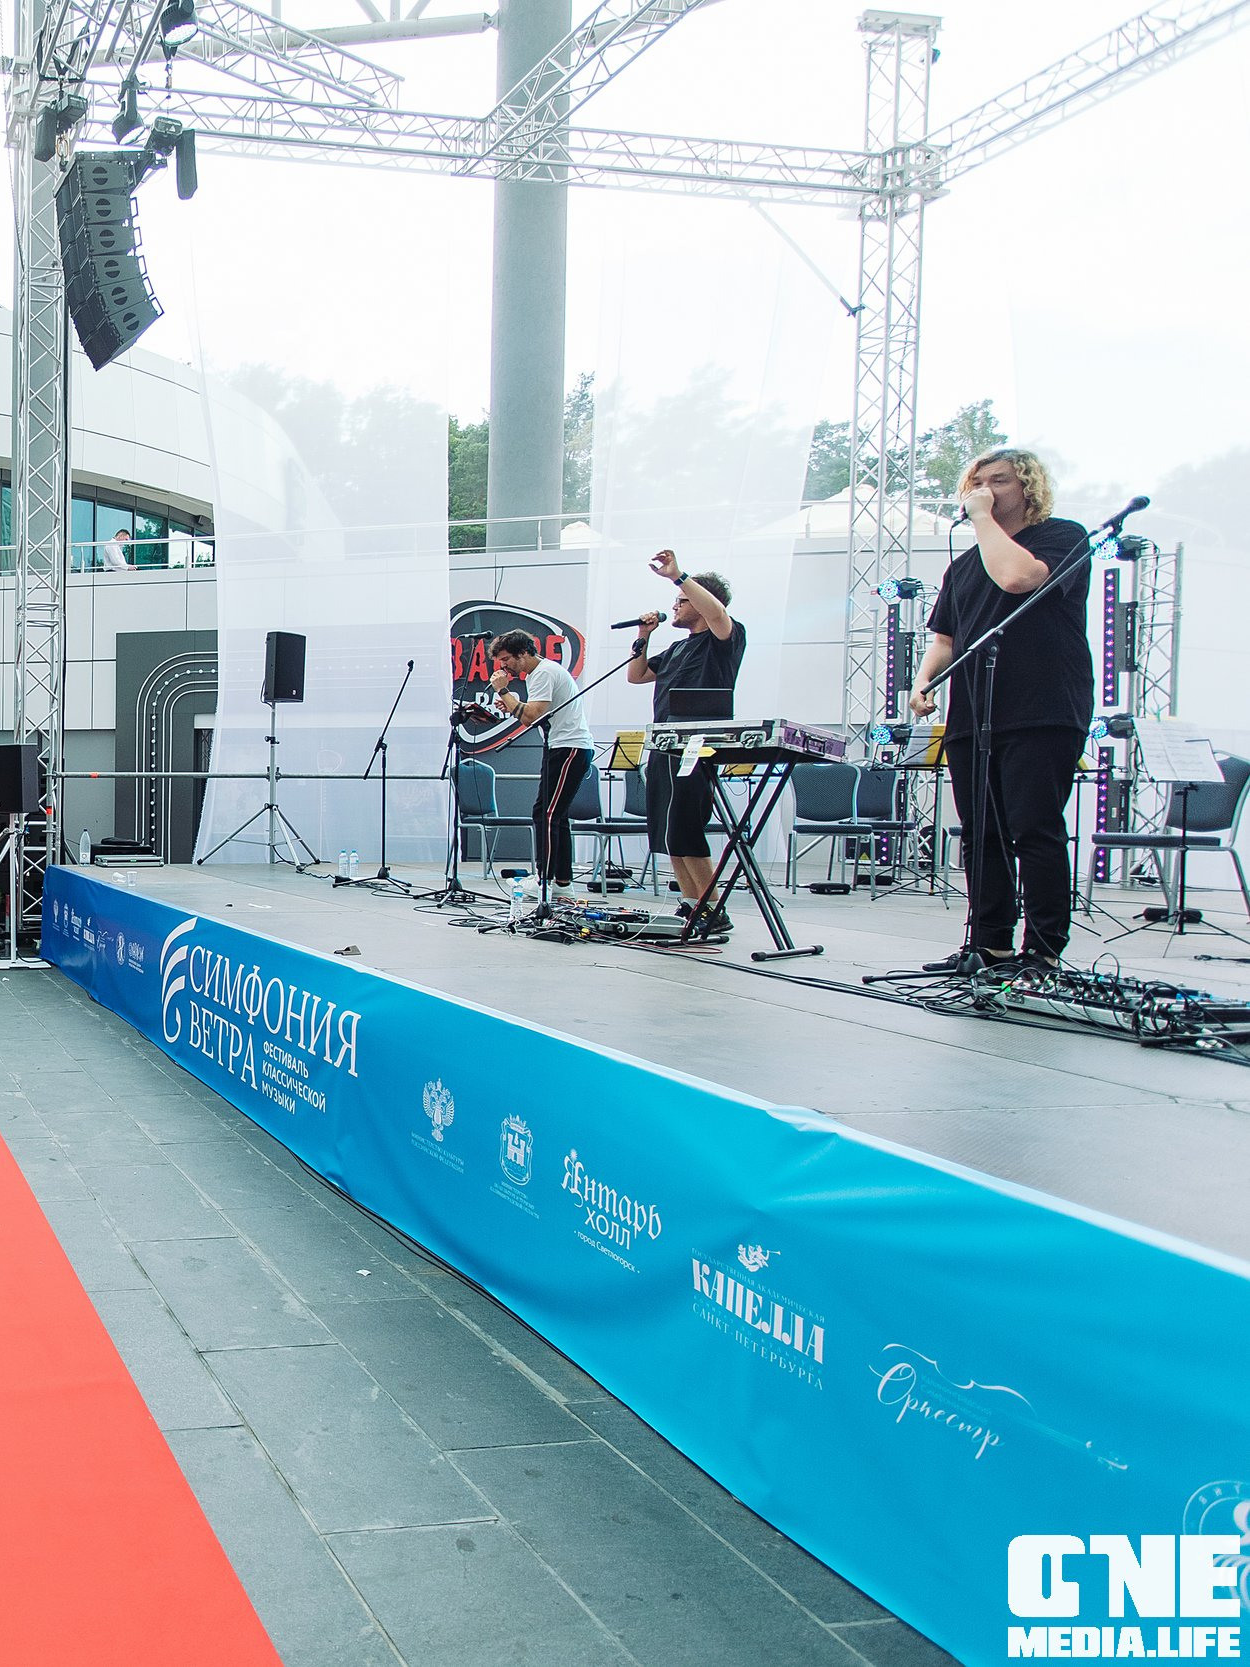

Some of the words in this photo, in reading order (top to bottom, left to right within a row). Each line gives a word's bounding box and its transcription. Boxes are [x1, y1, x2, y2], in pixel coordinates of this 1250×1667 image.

[188, 945, 362, 1078] СИМФОНИЯ
[188, 999, 259, 1091] ВЕТРА
[261, 1060, 327, 1113] КЛАССИЧЕСКОЙ
[262, 1040, 310, 1079] ФЕСТИВАЛЬ
[261, 1080, 297, 1115] МУЗЫКИ
[561, 1154, 662, 1240] Янтарь
[584, 1206, 631, 1251] ХОЛЛ
[577, 1231, 596, 1248] город
[596, 1241, 636, 1273] Светлогорск
[692, 1257, 825, 1365] КАПЕЛЛА
[692, 1302, 824, 1391] САНКТ-ПЕТЕРБУРГА
